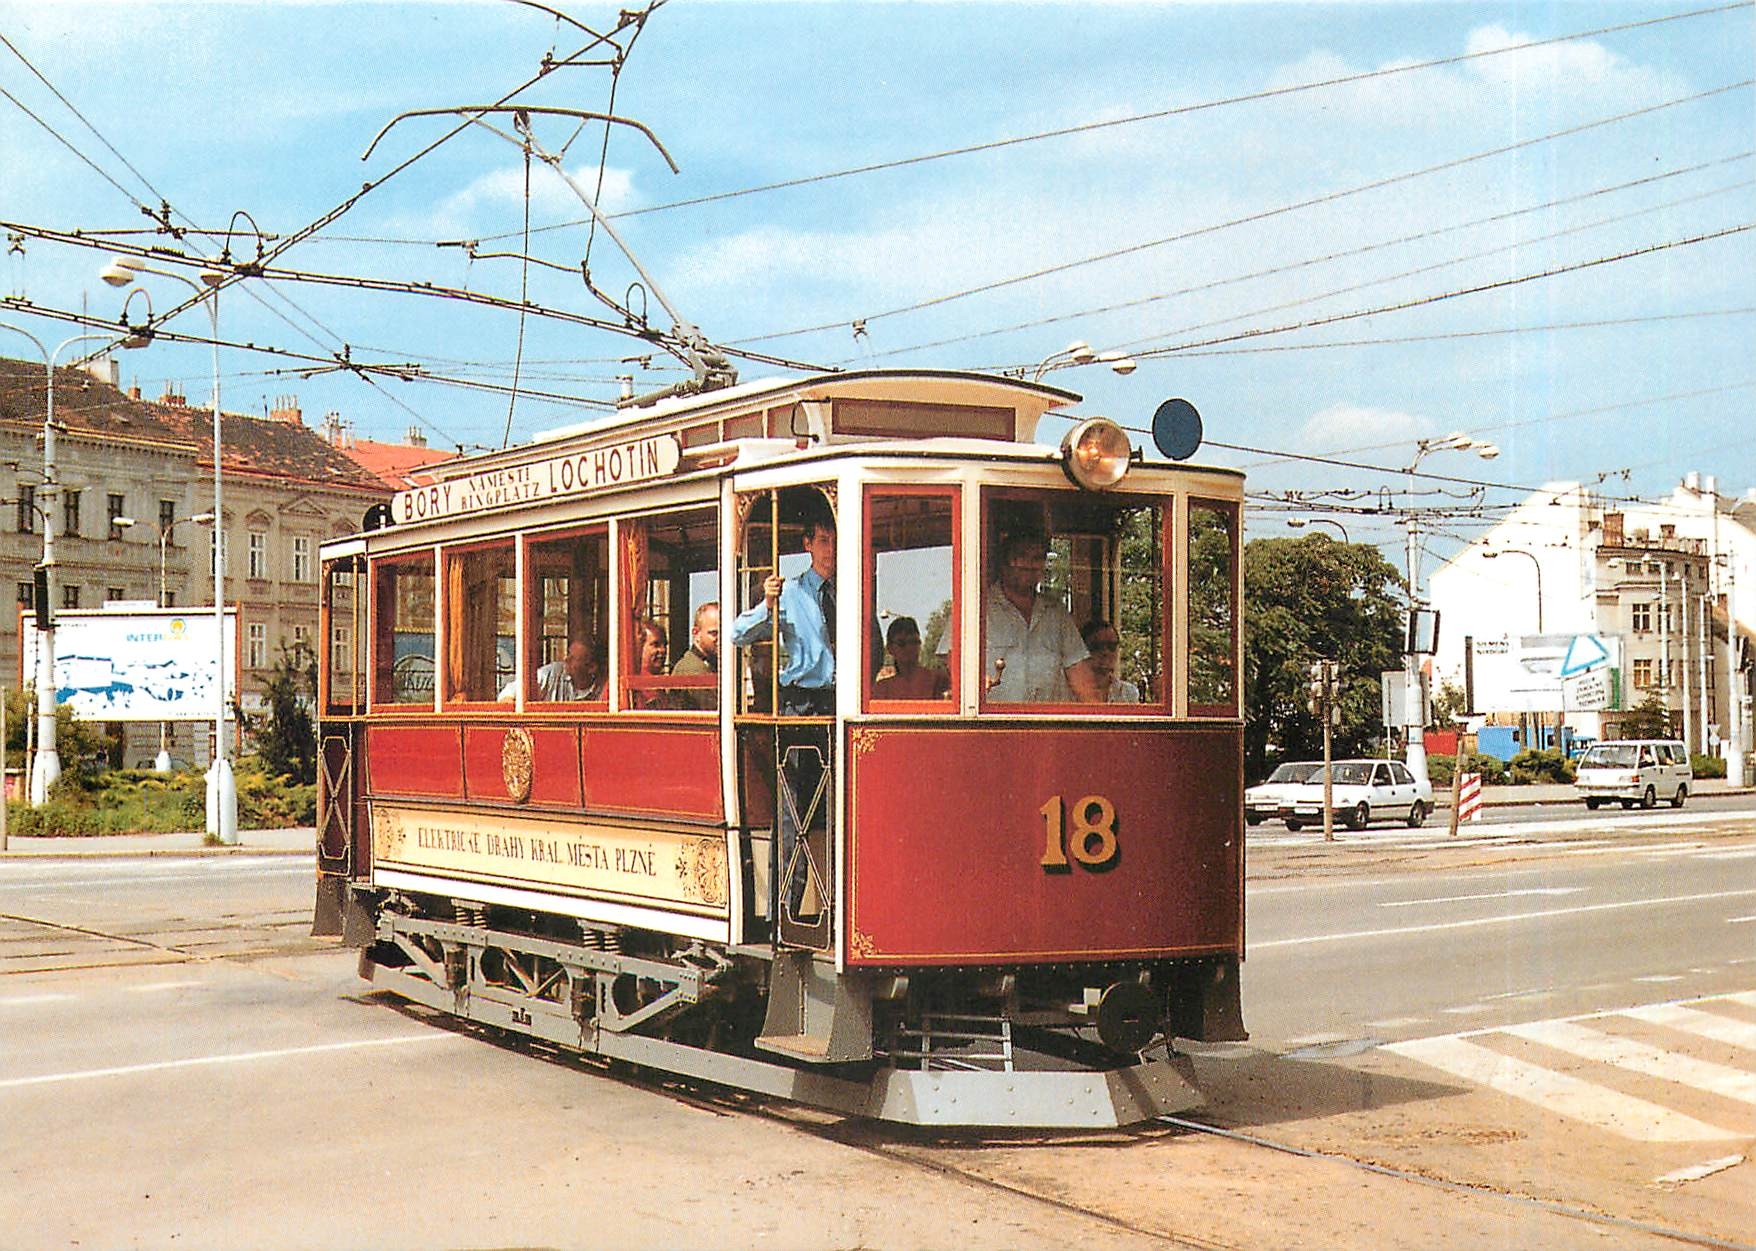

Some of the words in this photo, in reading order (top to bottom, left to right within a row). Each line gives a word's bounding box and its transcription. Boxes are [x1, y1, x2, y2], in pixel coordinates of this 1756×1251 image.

[404, 484, 452, 520] BORY
[461, 482, 541, 510] RINGPLATZ
[1040, 794, 1119, 872] 18
